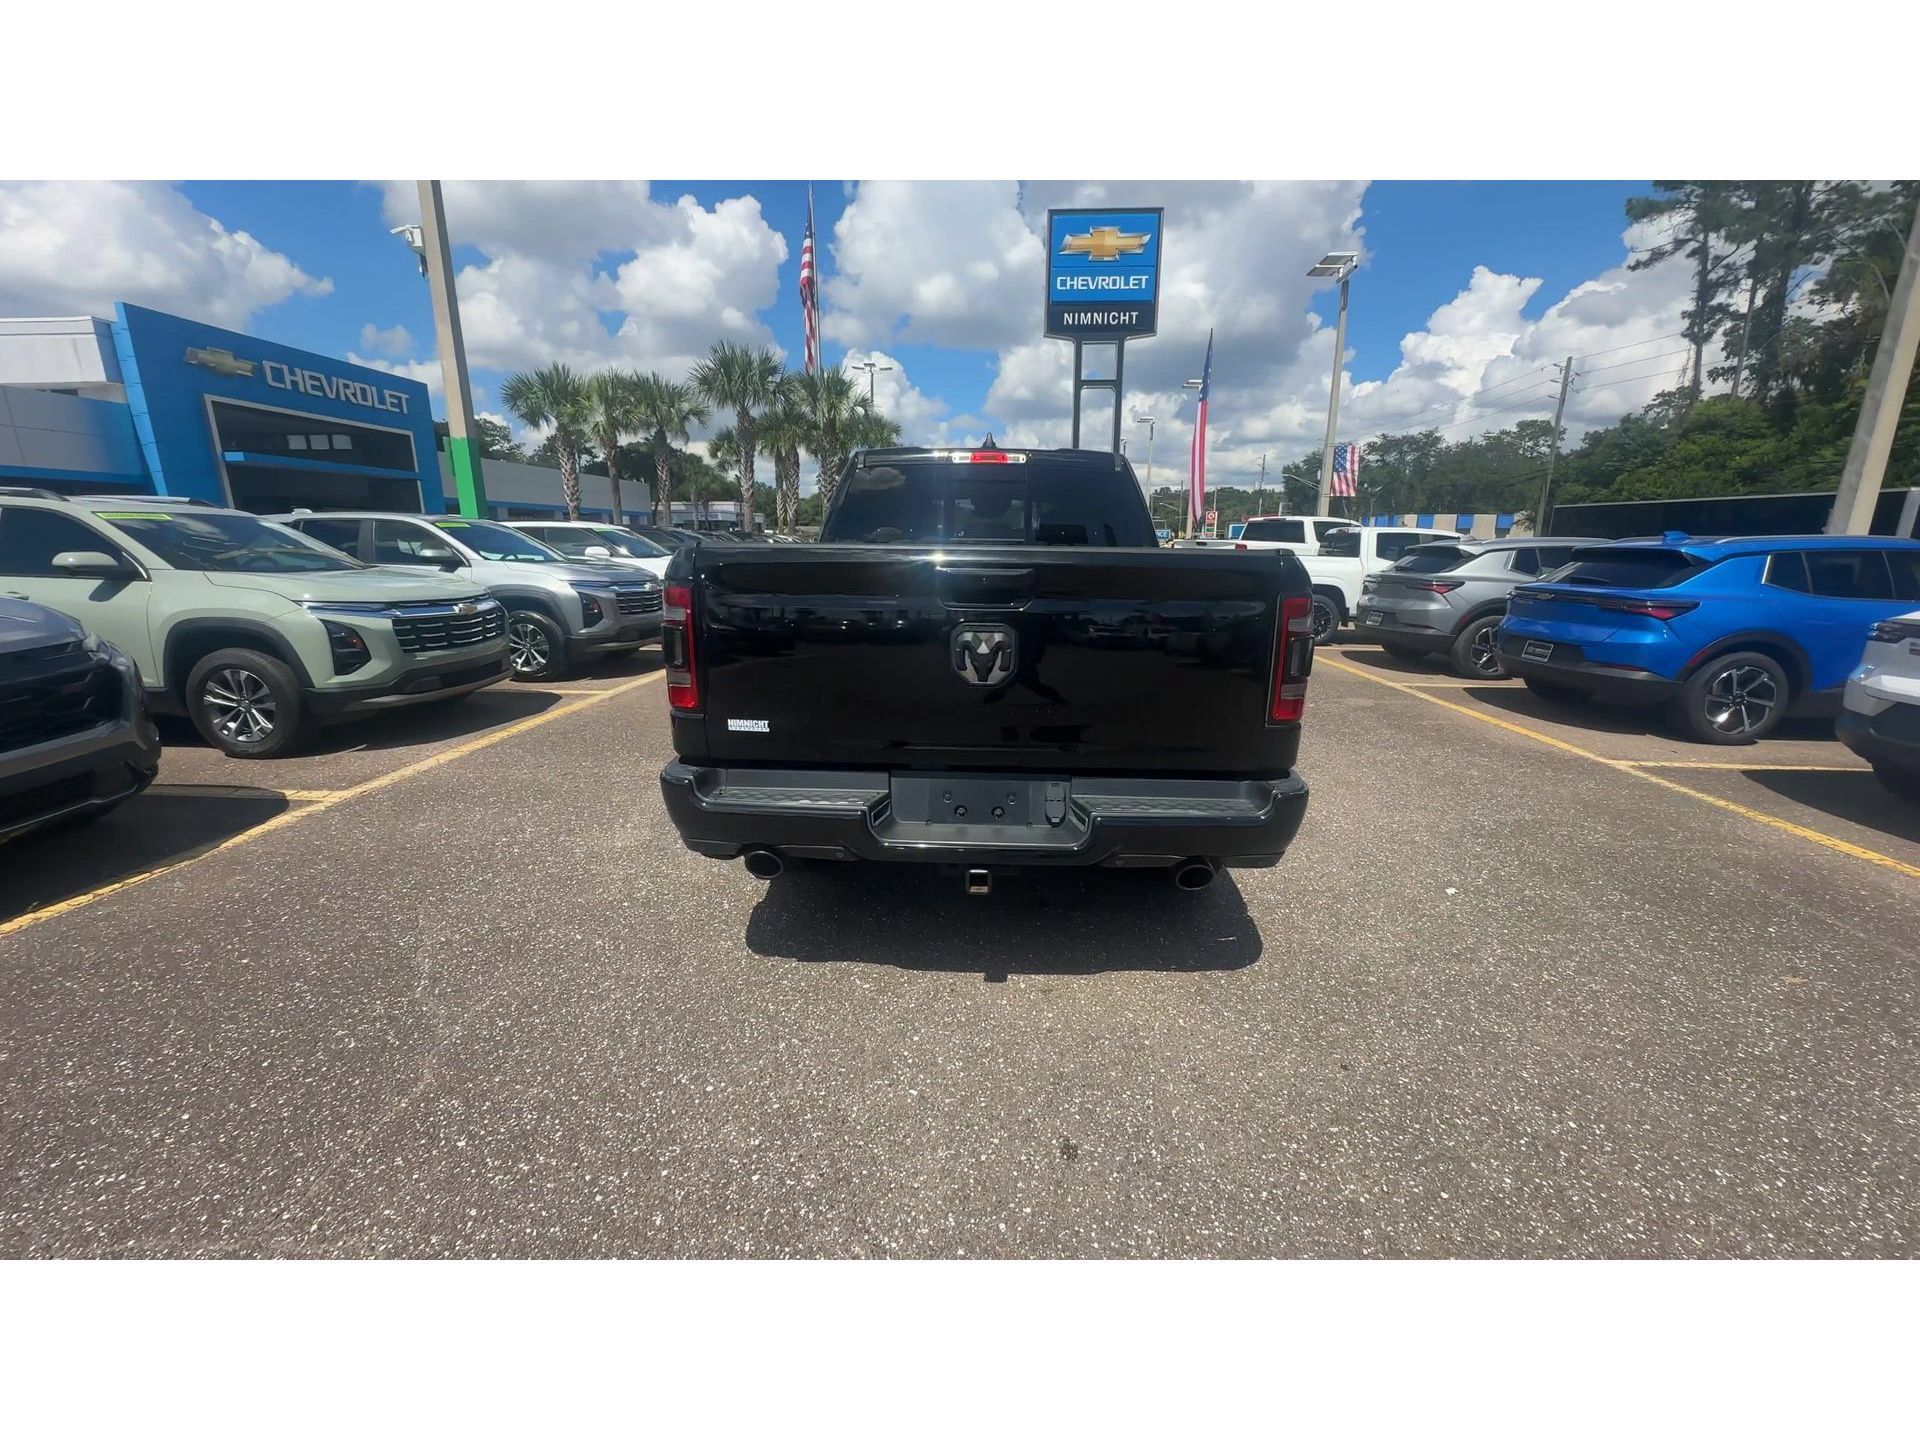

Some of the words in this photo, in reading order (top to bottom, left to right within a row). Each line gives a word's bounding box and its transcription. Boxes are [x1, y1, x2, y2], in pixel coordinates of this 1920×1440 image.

[1056, 275, 1149, 290] CHEVROLET
[1063, 311, 1139, 325] NIMNICHT
[262, 360, 410, 415] CHEVROLET
[727, 718, 770, 728] NIMNICHT
